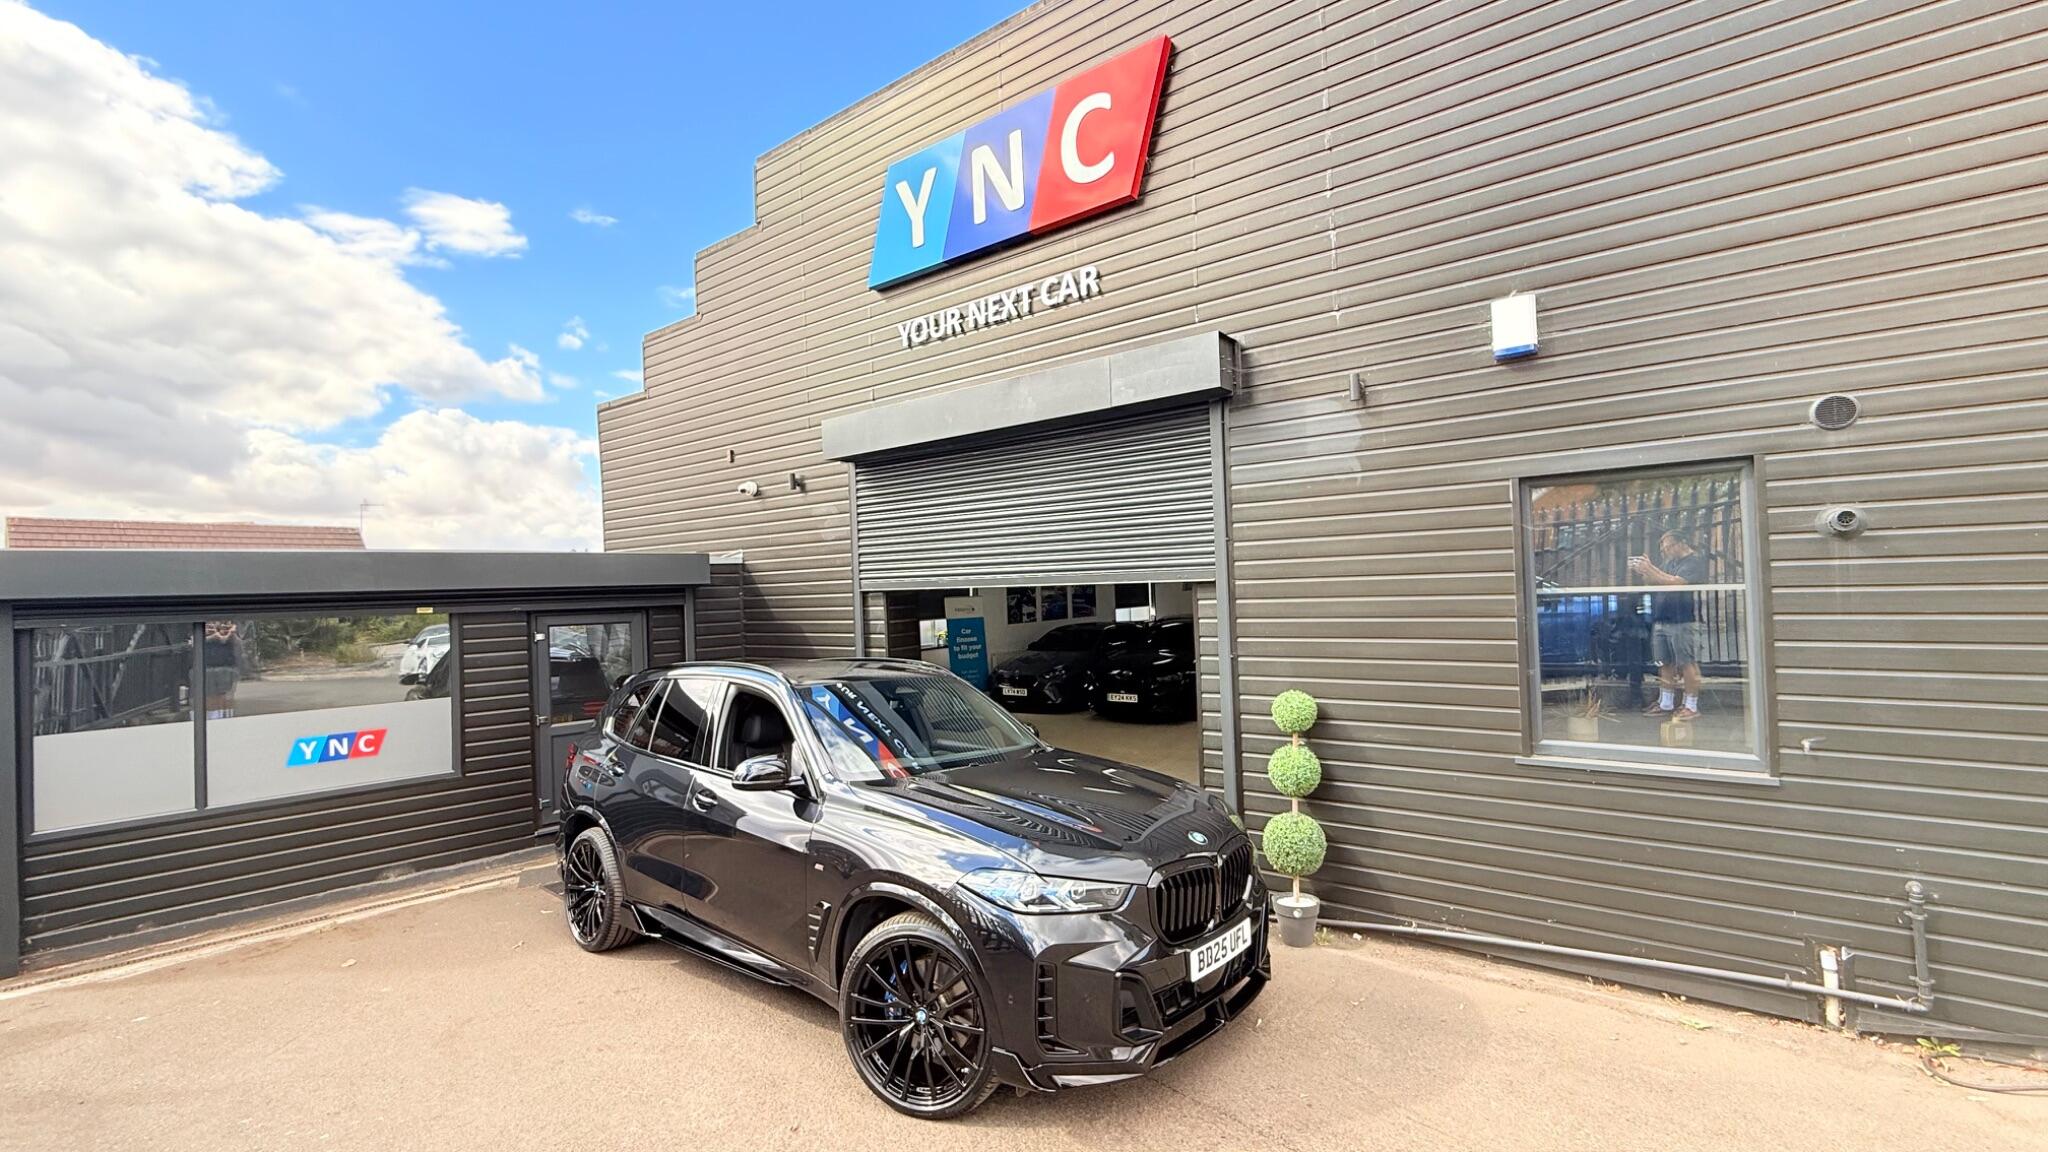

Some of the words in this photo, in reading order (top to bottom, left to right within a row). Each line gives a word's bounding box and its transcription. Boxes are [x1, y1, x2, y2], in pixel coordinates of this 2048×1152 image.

[895, 92, 1115, 248] YNC
[897, 308, 962, 348] YOUR
[967, 284, 1035, 327] NEXT
[1039, 264, 1101, 305] CAR
[957, 652, 979, 660] budget
[968, 643, 982, 652] your
[298, 734, 375, 760] YNC
[1198, 936, 1228, 973] BD25
[1229, 924, 1248, 953] UFL
